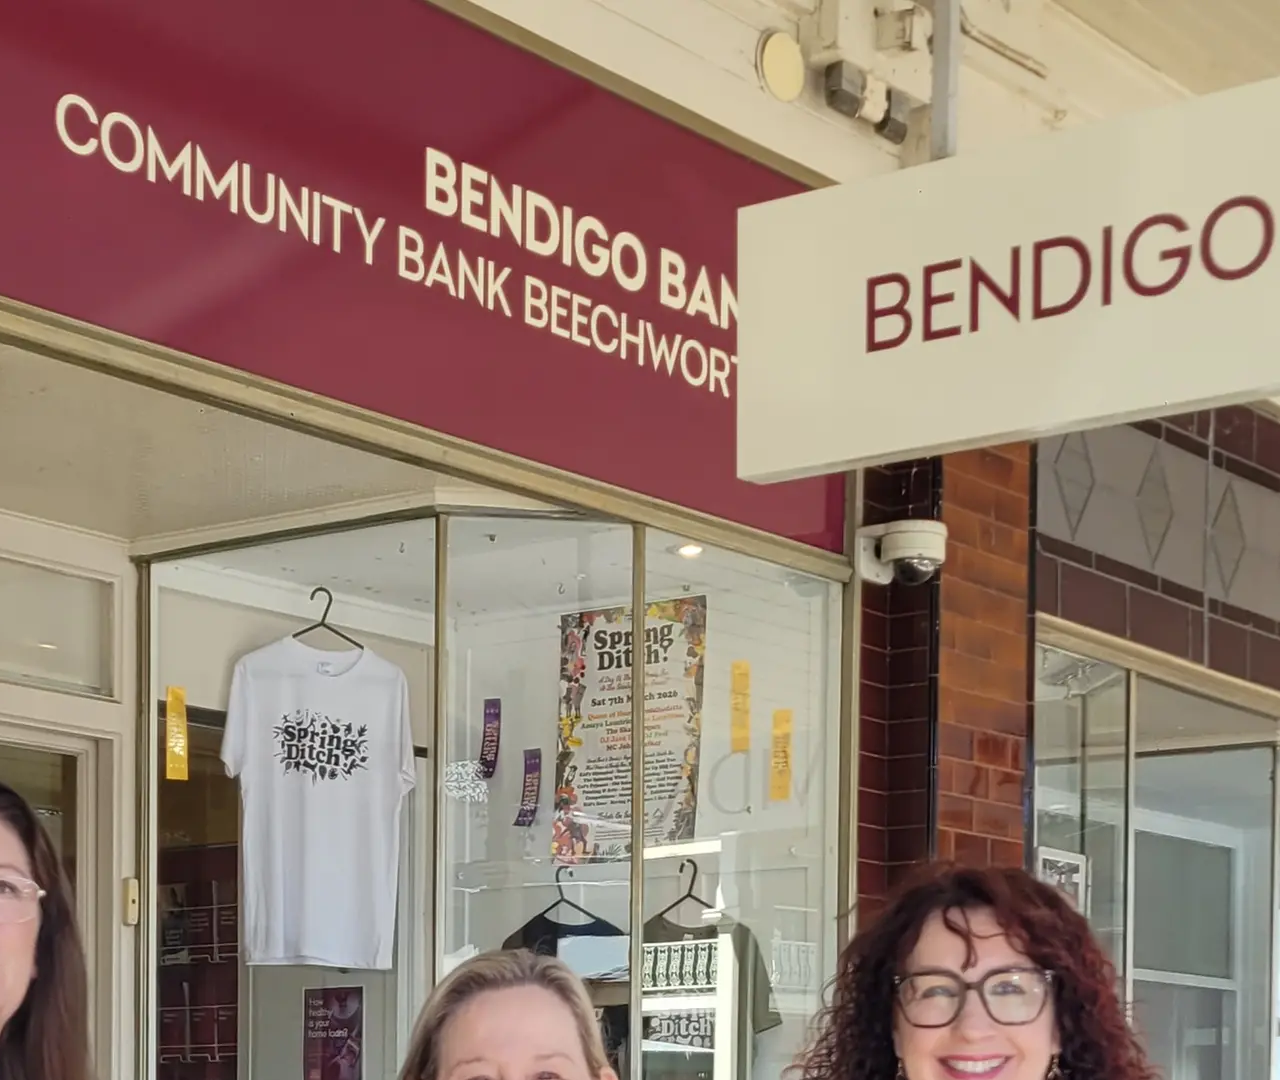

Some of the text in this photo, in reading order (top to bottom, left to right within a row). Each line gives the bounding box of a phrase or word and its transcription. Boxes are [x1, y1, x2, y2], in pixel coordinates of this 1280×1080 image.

[55, 93, 738, 399] COMMUNITY BANK BEECHWOR
[425, 146, 648, 292] BENDIGO
[865, 195, 1276, 353] BENDIGO
[593, 623, 674, 651] Sprng
[282, 722, 357, 757] Spring
[590, 698, 607, 708] Sat
[609, 695, 625, 707] 7th
[657, 689, 678, 699] 2026
